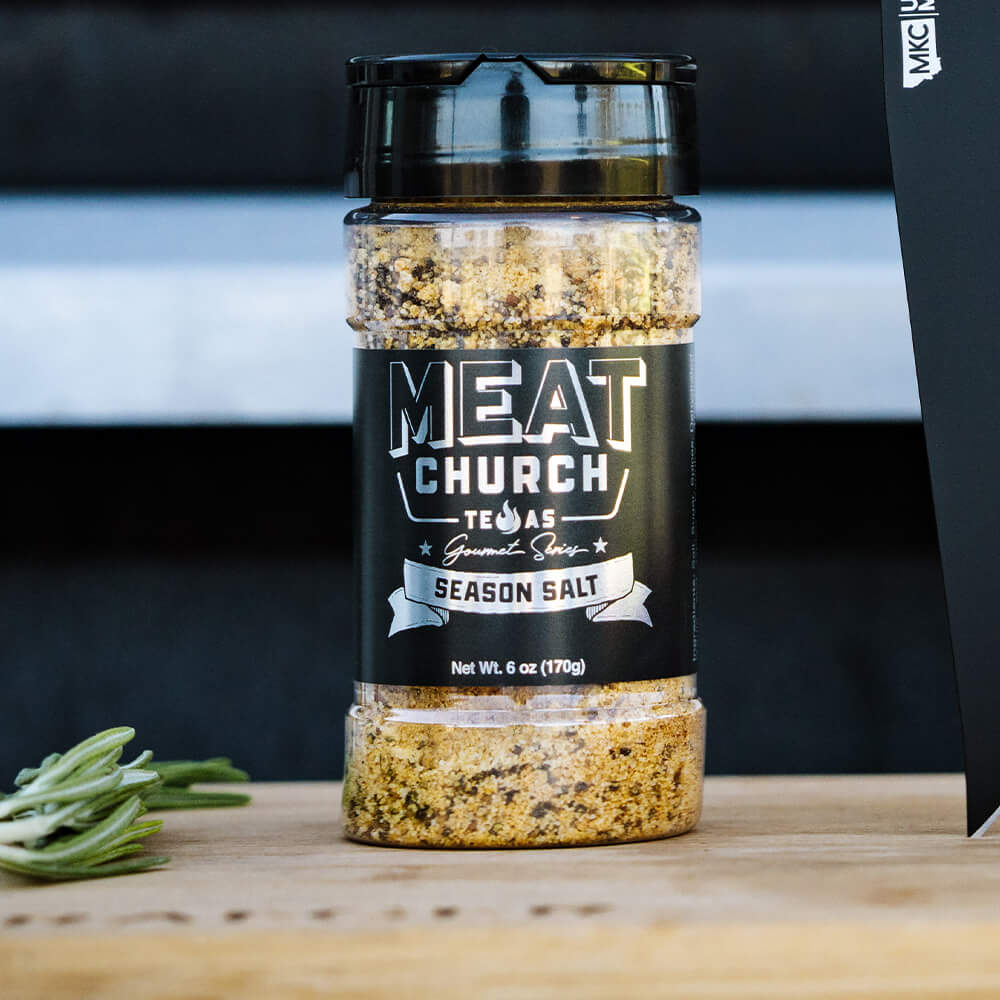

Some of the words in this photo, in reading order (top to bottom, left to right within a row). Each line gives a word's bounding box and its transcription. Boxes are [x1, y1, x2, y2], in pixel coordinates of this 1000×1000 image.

[908, 23, 930, 74] MKC
[388, 358, 648, 459] MEAT
[415, 454, 608, 494] CHURCH
[442, 533, 526, 566] Gourmet
[530, 532, 589, 561] Series
[434, 577, 533, 603] SEASON
[542, 574, 599, 601] SALT
[451, 661, 476, 675] Net
[479, 661, 503, 675] Wt.
[506, 661, 516, 675] 6
[519, 664, 537, 676] oz
[540, 658, 586, 676] (170g)
